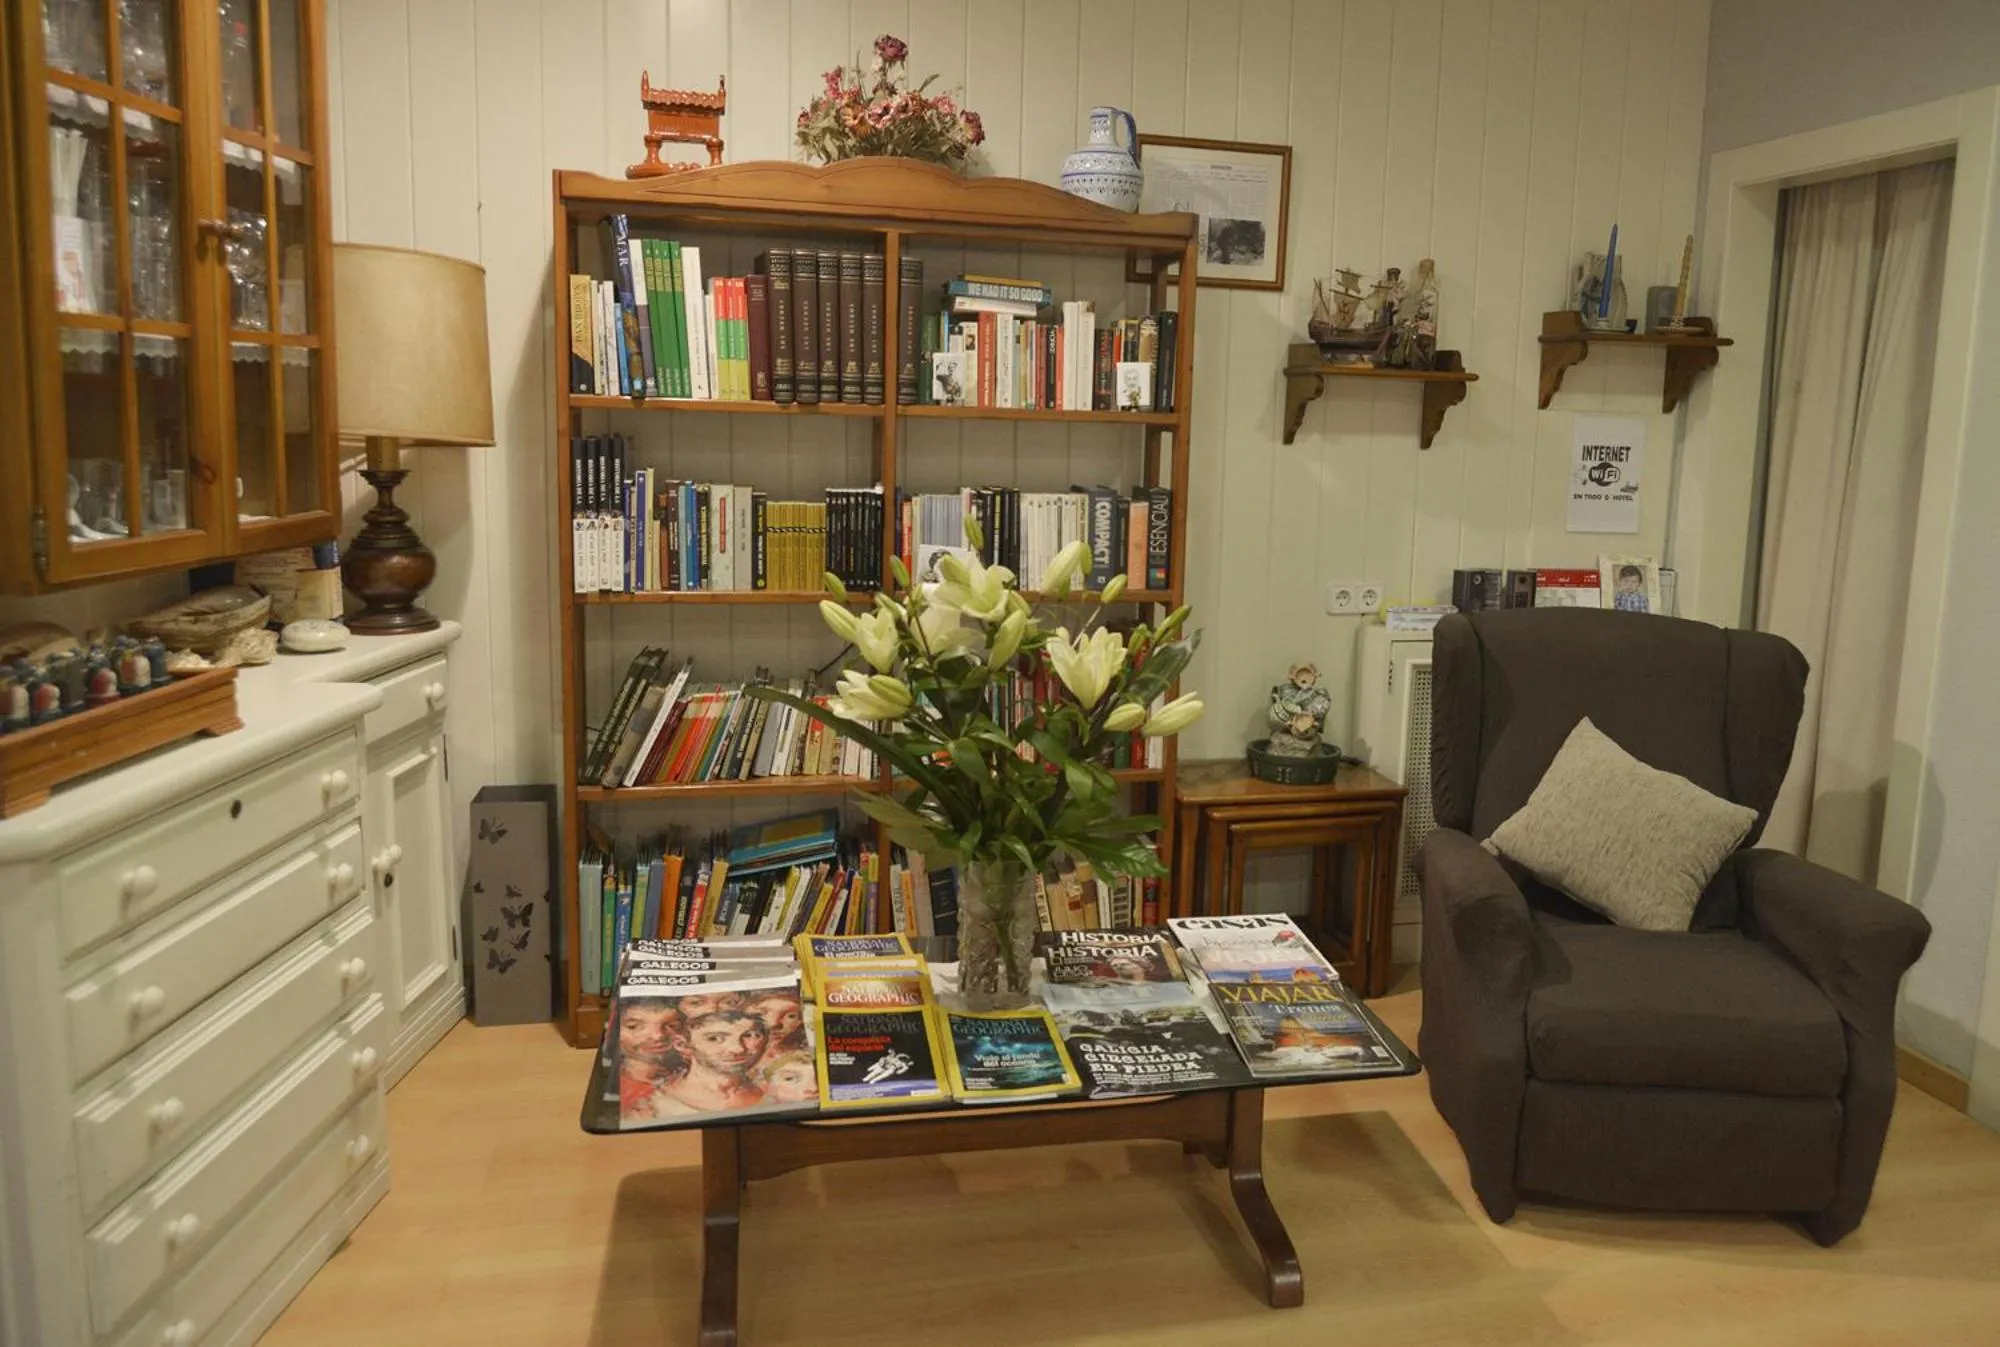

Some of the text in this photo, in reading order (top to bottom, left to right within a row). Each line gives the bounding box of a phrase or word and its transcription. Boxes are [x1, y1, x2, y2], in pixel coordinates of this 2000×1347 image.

[968, 283, 1043, 302] WE HAD IT SO GOOD
[1582, 445, 1631, 462] INTERNET
[1150, 498, 1169, 553] ESENCIAL
[1094, 501, 1112, 566] COMPACT
[1061, 931, 1167, 945] HISTORIA
[1048, 945, 1158, 958] HISTORIA
[640, 961, 710, 970] GALEGOS
[627, 976, 699, 985] GALEGOS
[828, 991, 918, 1004] GEOGRAPHIC
[1218, 985, 1338, 1004] VIAJAR
[1268, 1004, 1341, 1014] Trenes
[826, 1022, 920, 1033] GEOGRAPHIC
[953, 1023, 1043, 1035] GEOGRAPHIC
[1122, 1061, 1201, 1074] PIEDRA
